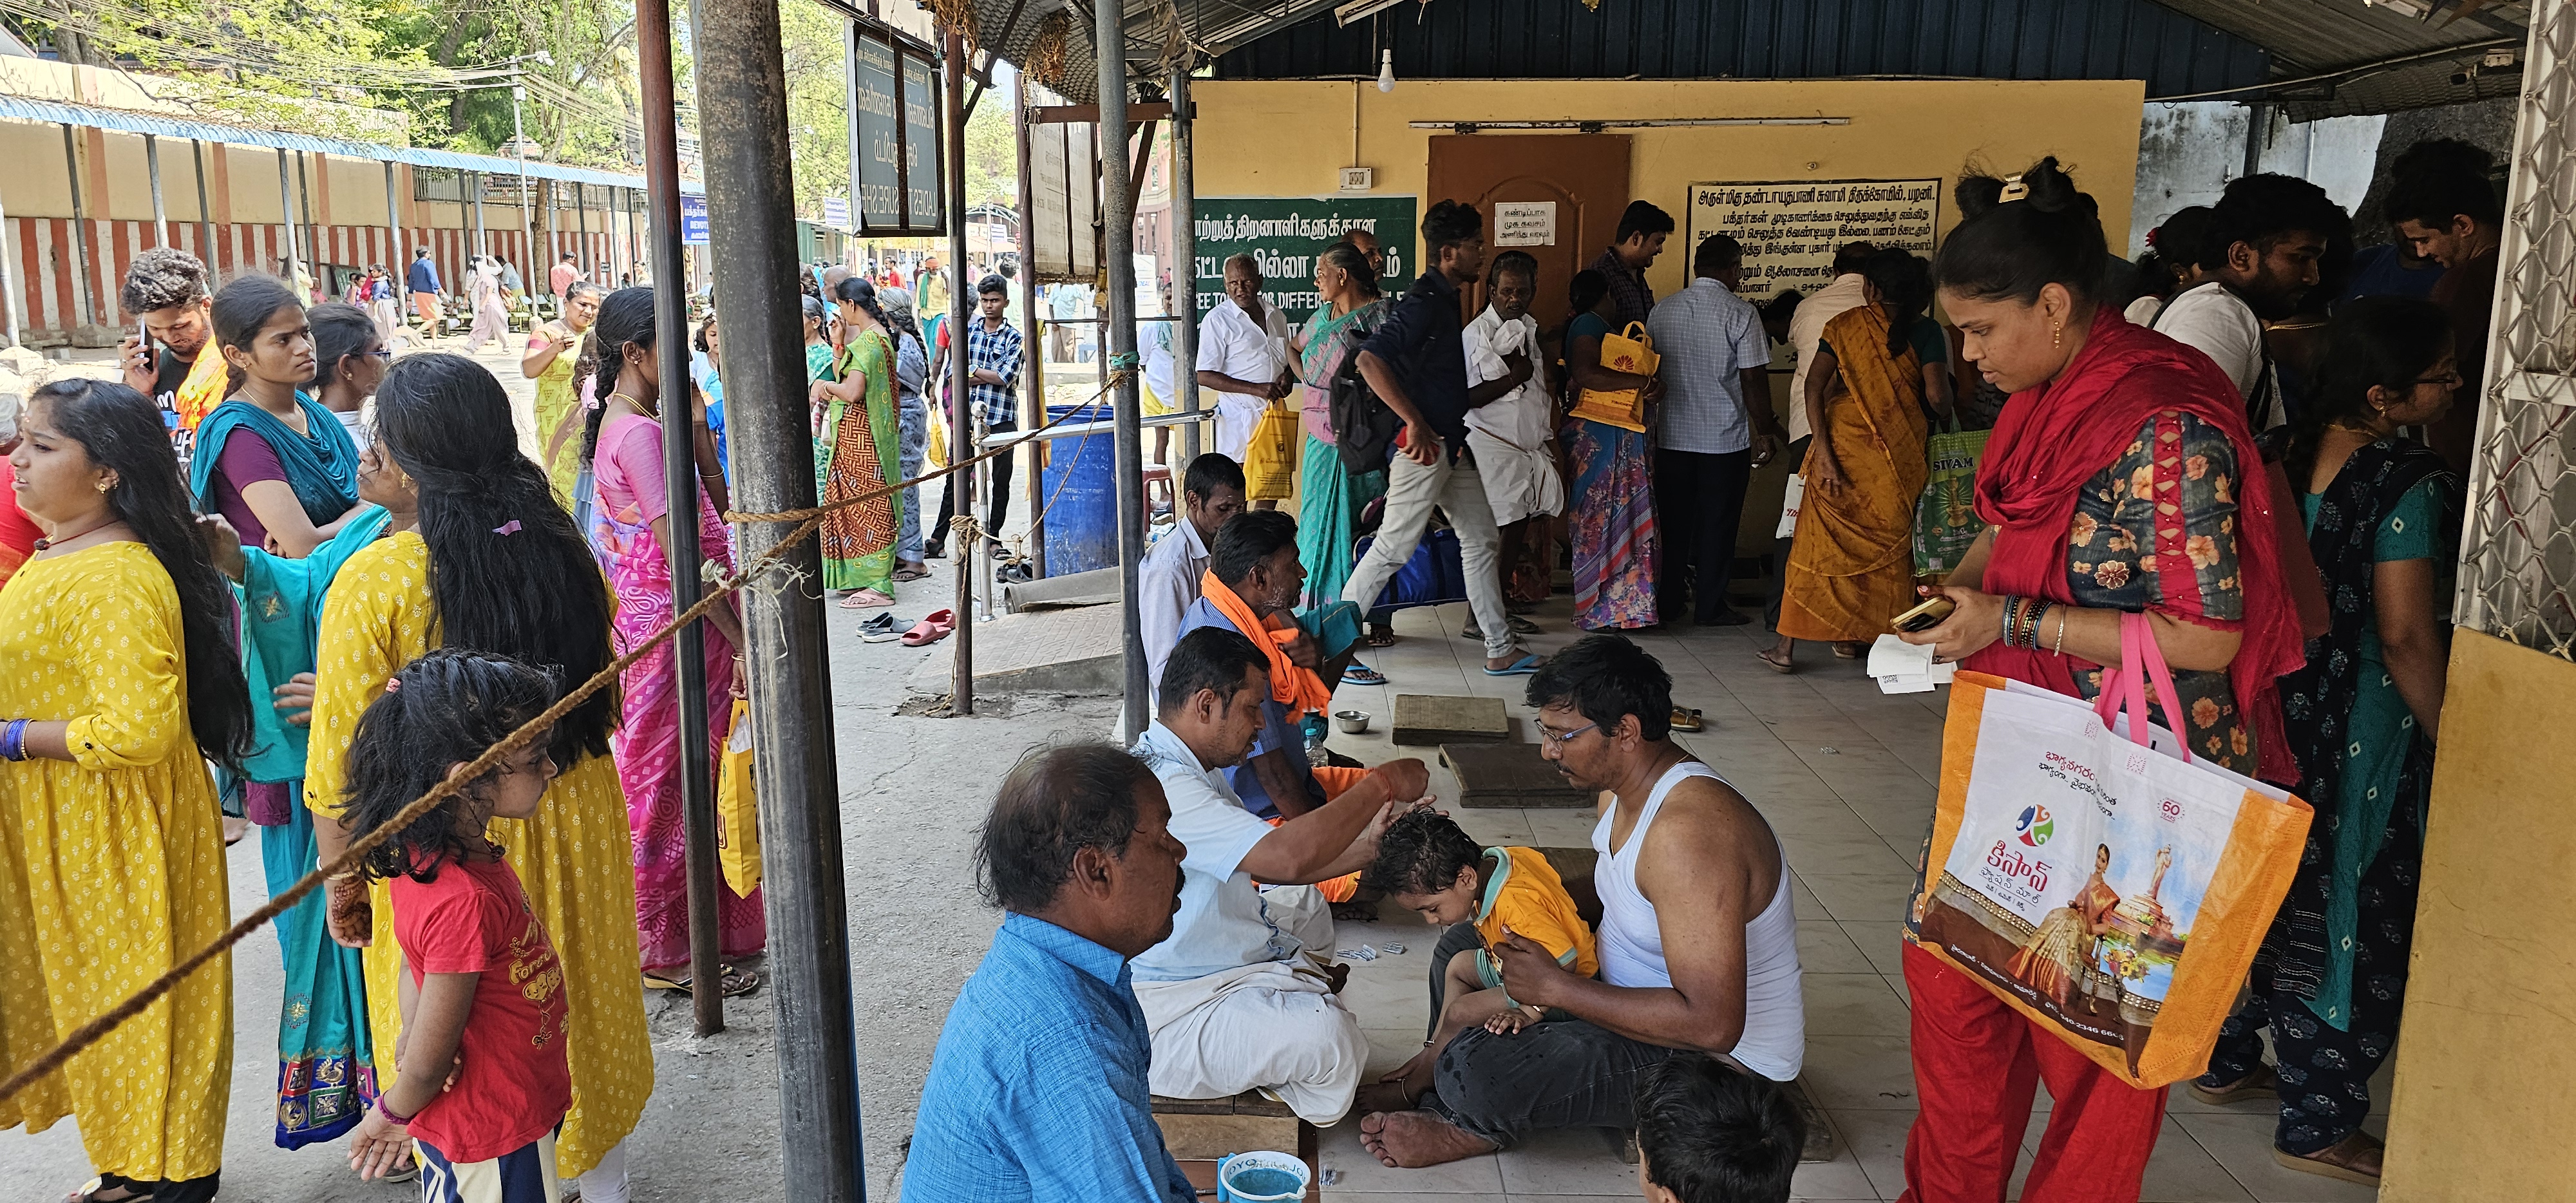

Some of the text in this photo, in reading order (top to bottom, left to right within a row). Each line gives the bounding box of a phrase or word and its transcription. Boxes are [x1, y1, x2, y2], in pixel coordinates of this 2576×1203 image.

[1817, 187, 1846, 203] சுவாமி
[1847, 185, 1906, 205] திருக்கோயில்,
[1908, 185, 1935, 205] பழனி.
[1504, 209, 1546, 218] கண்டிப்பாக
[1723, 210, 1768, 226] பக்தர்கள்
[1834, 208, 1897, 224] செலுத்துவதற்கு
[1899, 207, 1929, 222] எவ்வித
[1195, 213, 1377, 242] ாற்றுத்திறனாளிகளுக்கான
[1521, 219, 1546, 228] கவசம்
[1747, 227, 1784, 242] செலுத்த
[1786, 225, 1835, 240] வேண்டியது
[1839, 224, 1871, 237] இல்லை.
[1873, 223, 1896, 236] பணம்
[1898, 223, 1931, 237] கேட்கும்
[1765, 242, 1806, 256] இங்குள்ள
[1808, 241, 1831, 256] புகார்
[1765, 265, 1821, 279] ஆலோசனை
[1933, 457, 1974, 471] SIVAM
[2045, 752, 2095, 781] భాగ్యనగరం
[2163, 801, 2180, 815] 60
[1987, 840, 2052, 892] కిసాన్
